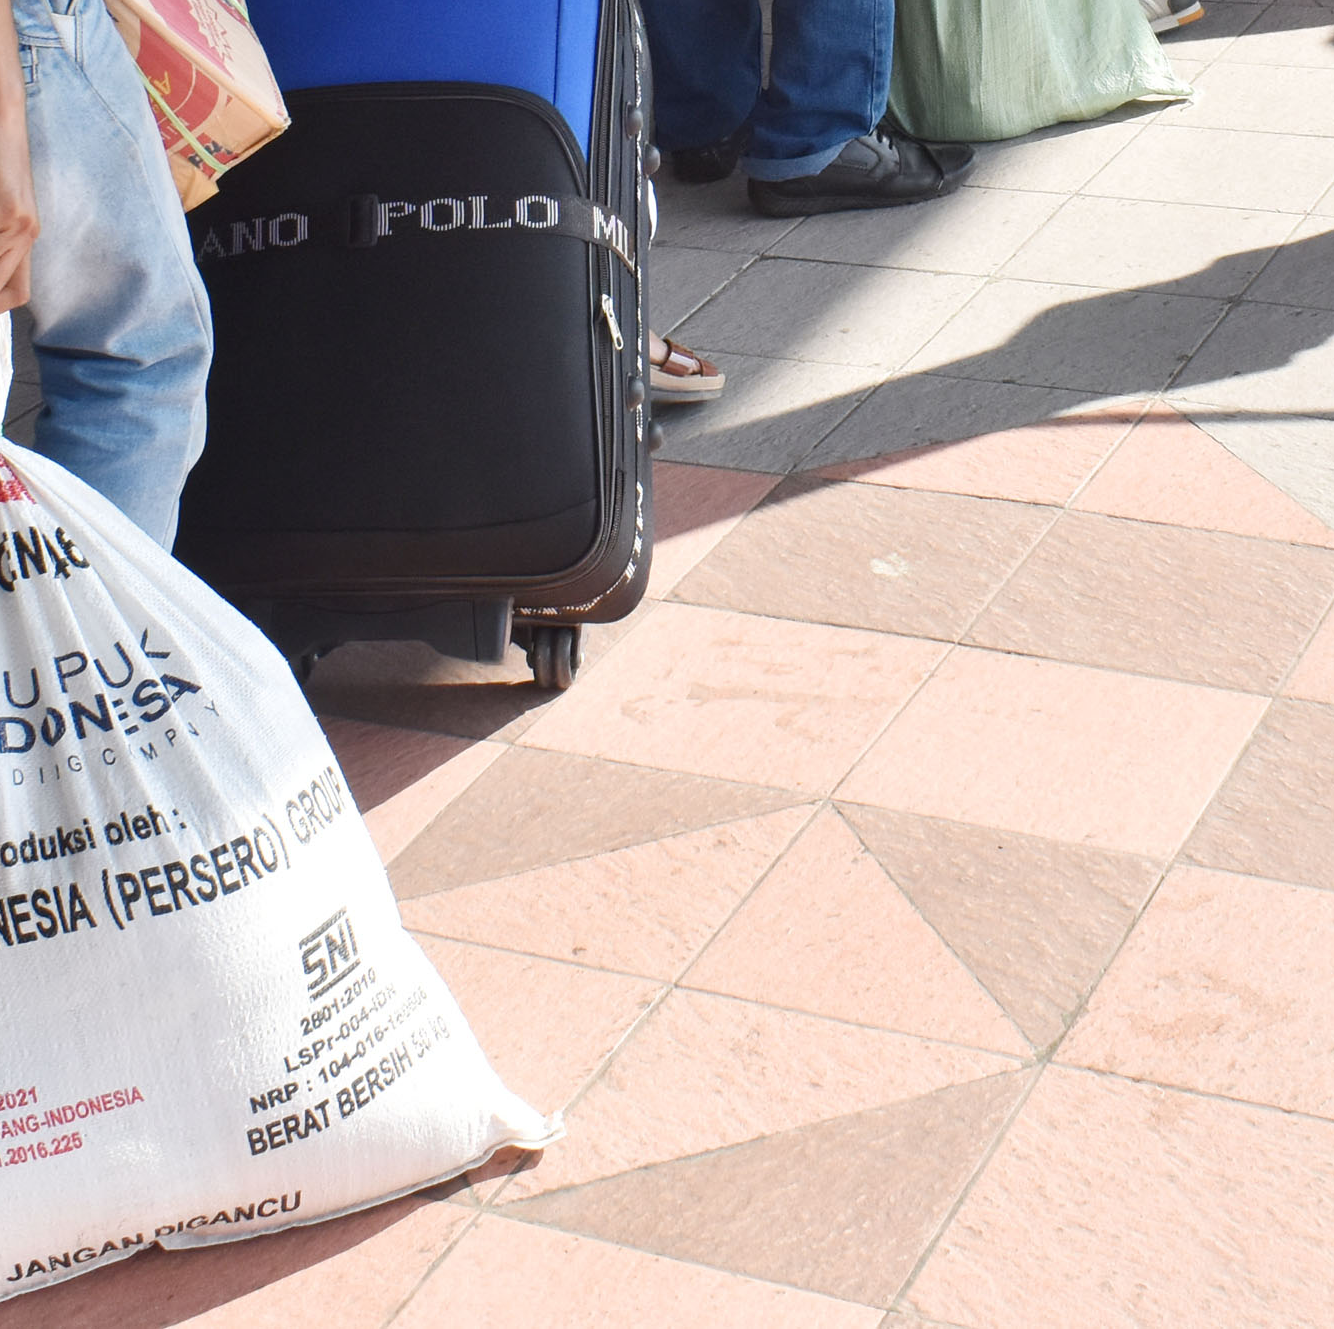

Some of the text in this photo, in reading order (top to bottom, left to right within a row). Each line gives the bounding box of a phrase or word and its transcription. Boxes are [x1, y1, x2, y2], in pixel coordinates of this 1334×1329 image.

[378, 194, 559, 237] POLO
[104, 804, 171, 846] oleh
[101, 812, 292, 931] (PERSERO)
[301, 917, 359, 993] SNI
[246, 1098, 331, 1156] BERAT
[336, 1041, 414, 1120] BERSIH
[249, 1081, 300, 1115] NRP
[6, 1189, 302, 1283] JANGAN DIGANCU
